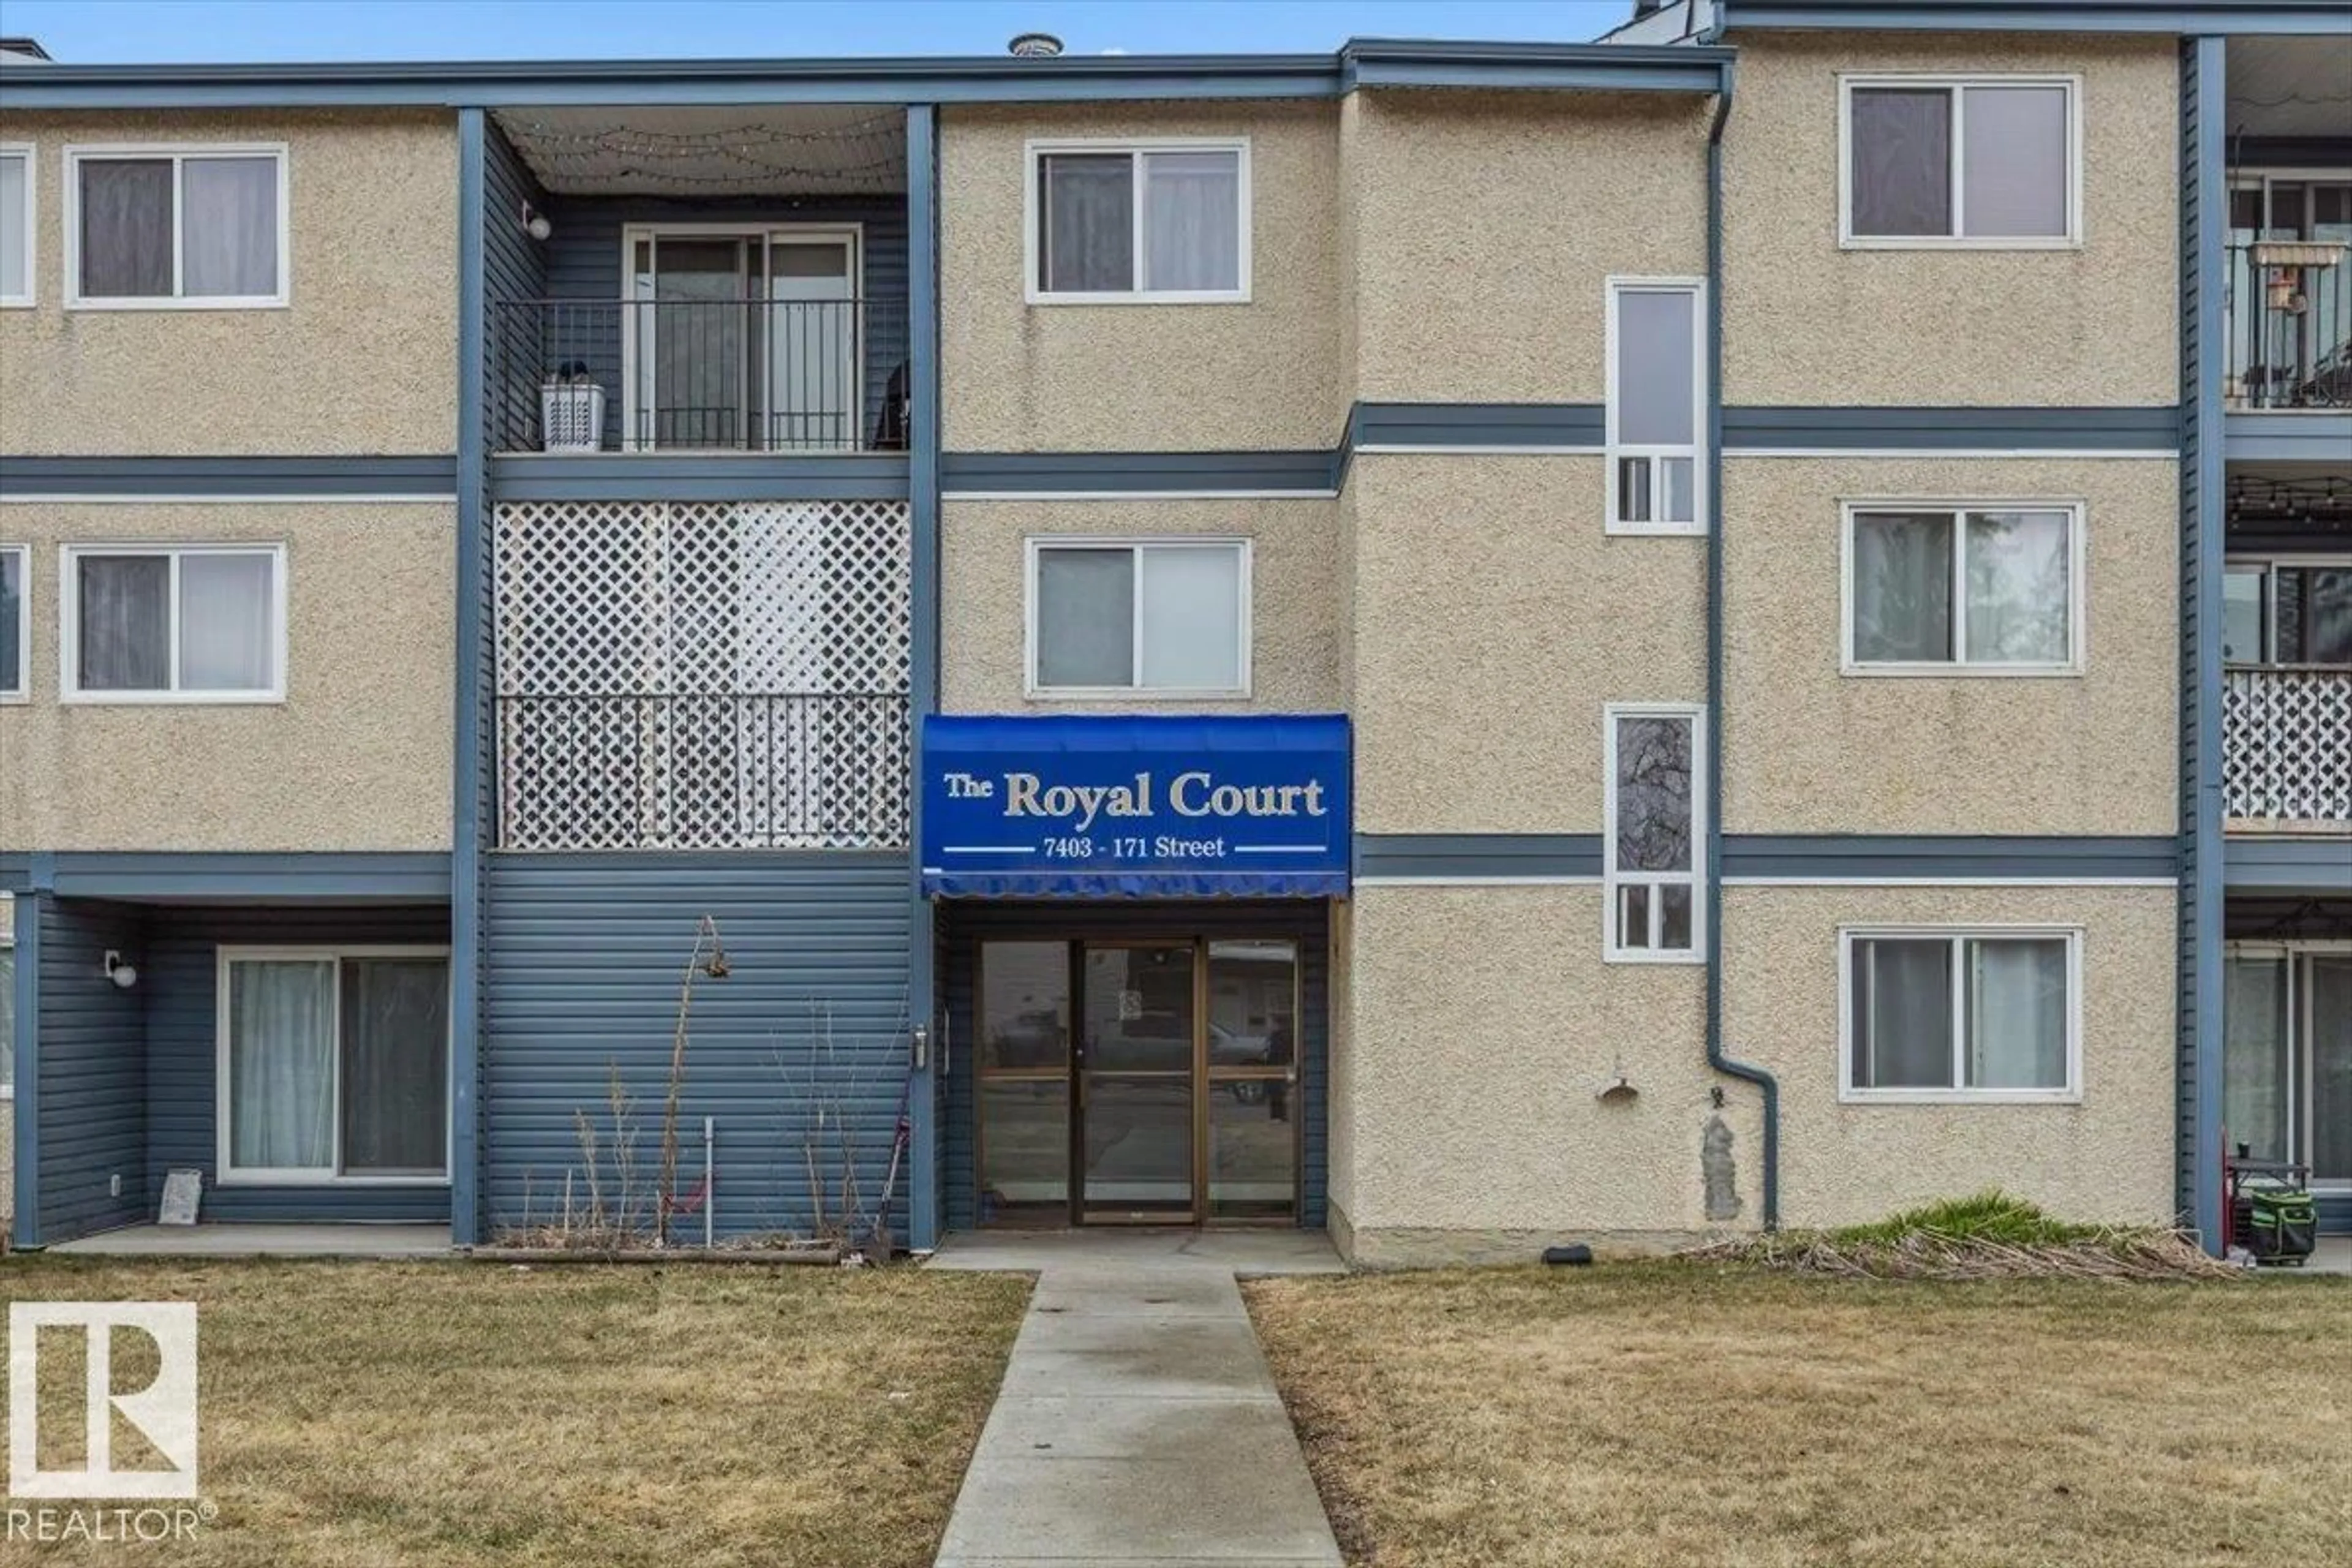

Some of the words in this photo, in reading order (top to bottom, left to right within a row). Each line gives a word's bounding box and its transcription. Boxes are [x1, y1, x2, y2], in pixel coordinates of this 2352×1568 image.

[944, 774, 993, 797] The
[1004, 772, 1153, 832] Royal
[1170, 772, 1327, 816] Court
[1044, 837, 1092, 858] 7403
[1113, 837, 1147, 858] 171
[1155, 837, 1226, 858] Street
